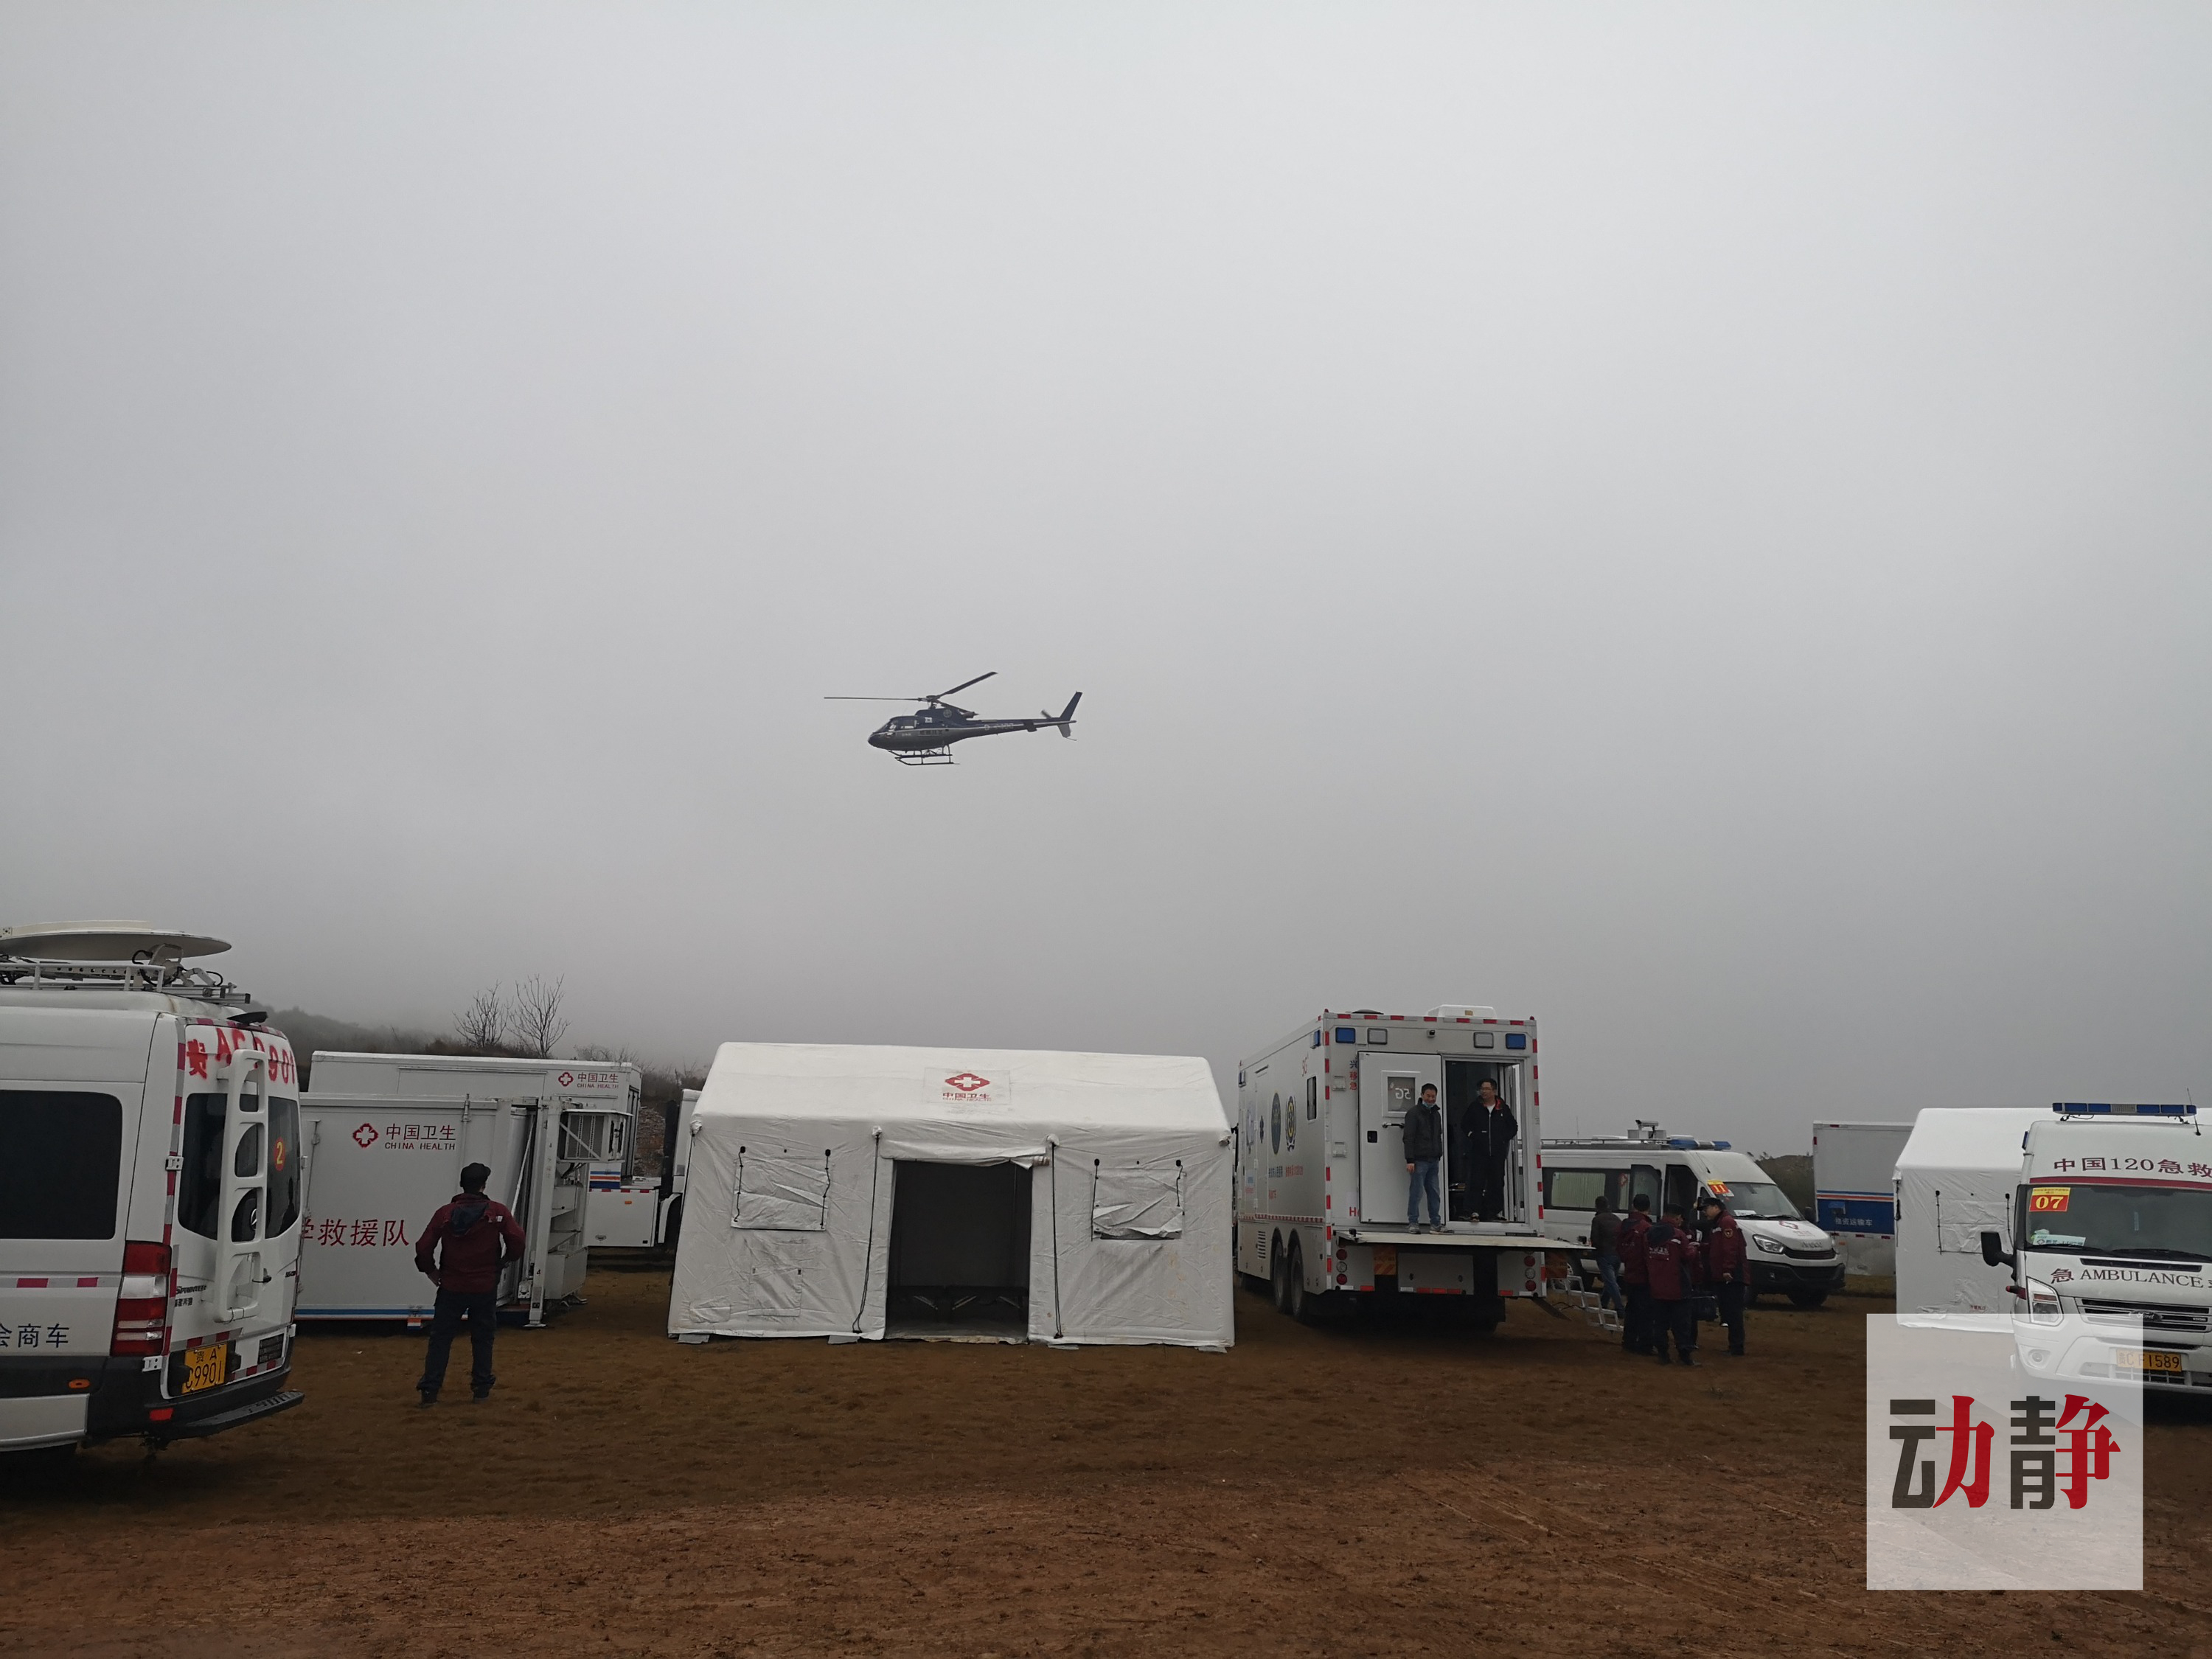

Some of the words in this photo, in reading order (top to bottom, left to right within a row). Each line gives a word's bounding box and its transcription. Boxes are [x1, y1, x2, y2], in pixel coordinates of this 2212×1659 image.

[577, 1072, 619, 1083] 中国卫生
[386, 1123, 456, 1141] 中国卫生
[276, 1141, 283, 1164] 2
[385, 1142, 414, 1150] CHINA
[2053, 1157, 2212, 1178] 中国120急救
[2035, 1196, 2064, 1209] 07
[2051, 1268, 2074, 1284] 急
[2080, 1270, 2204, 1289] AMBULANCE
